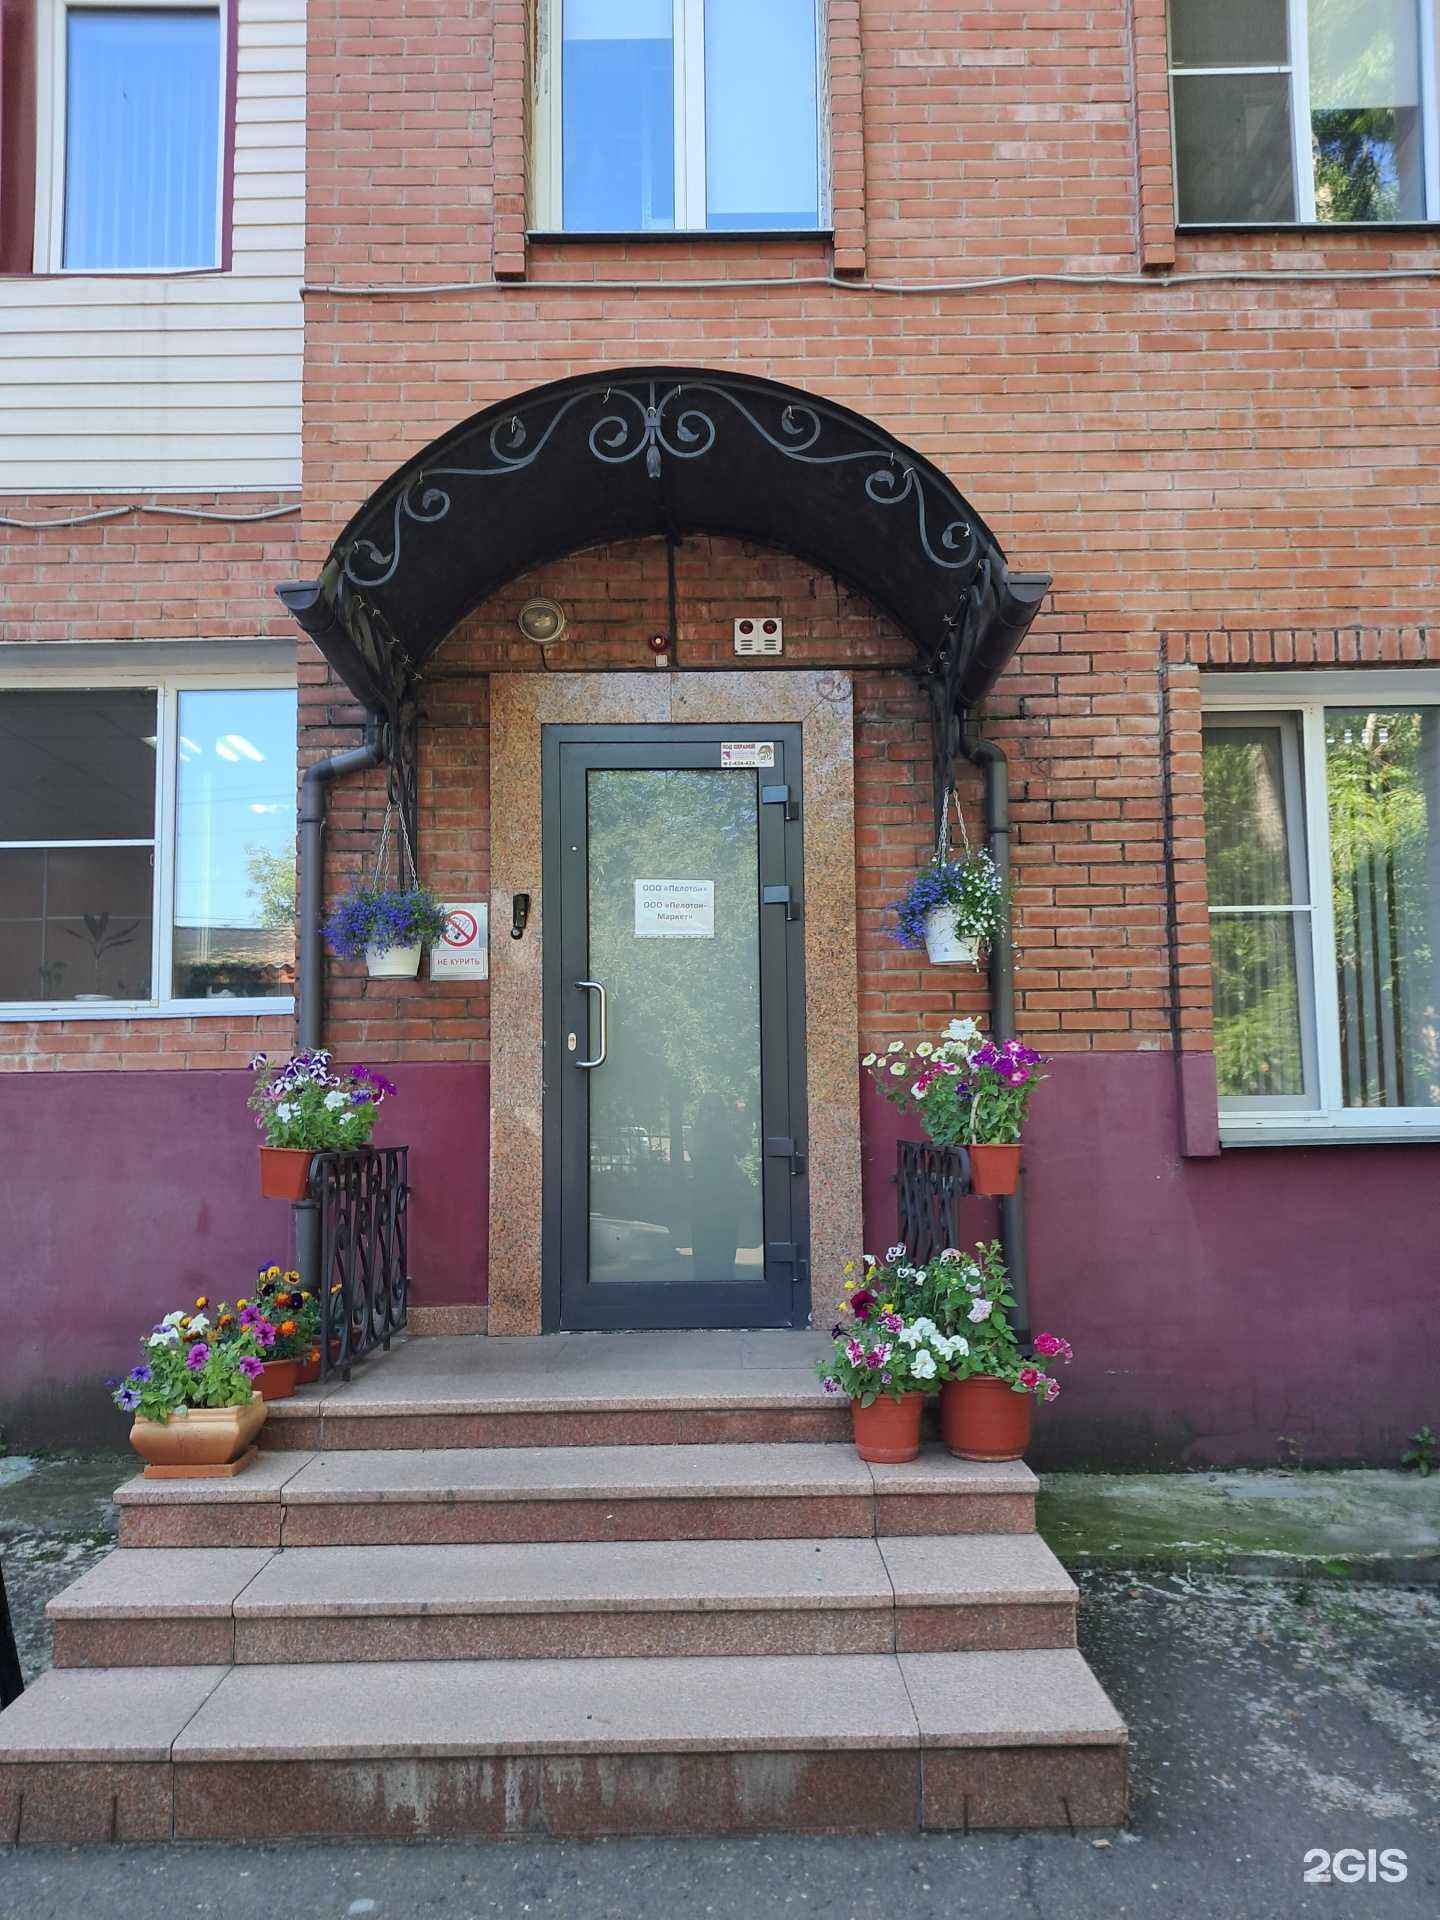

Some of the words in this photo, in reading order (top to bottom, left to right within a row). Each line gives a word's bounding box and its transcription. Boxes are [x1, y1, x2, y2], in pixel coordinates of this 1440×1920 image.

[642, 884, 662, 892] ООО
[643, 901, 663, 909] ООО
[657, 913, 693, 921] Маркет»
[437, 958, 448, 966] НЕ
[450, 958, 480, 966] КУРИТЬ
